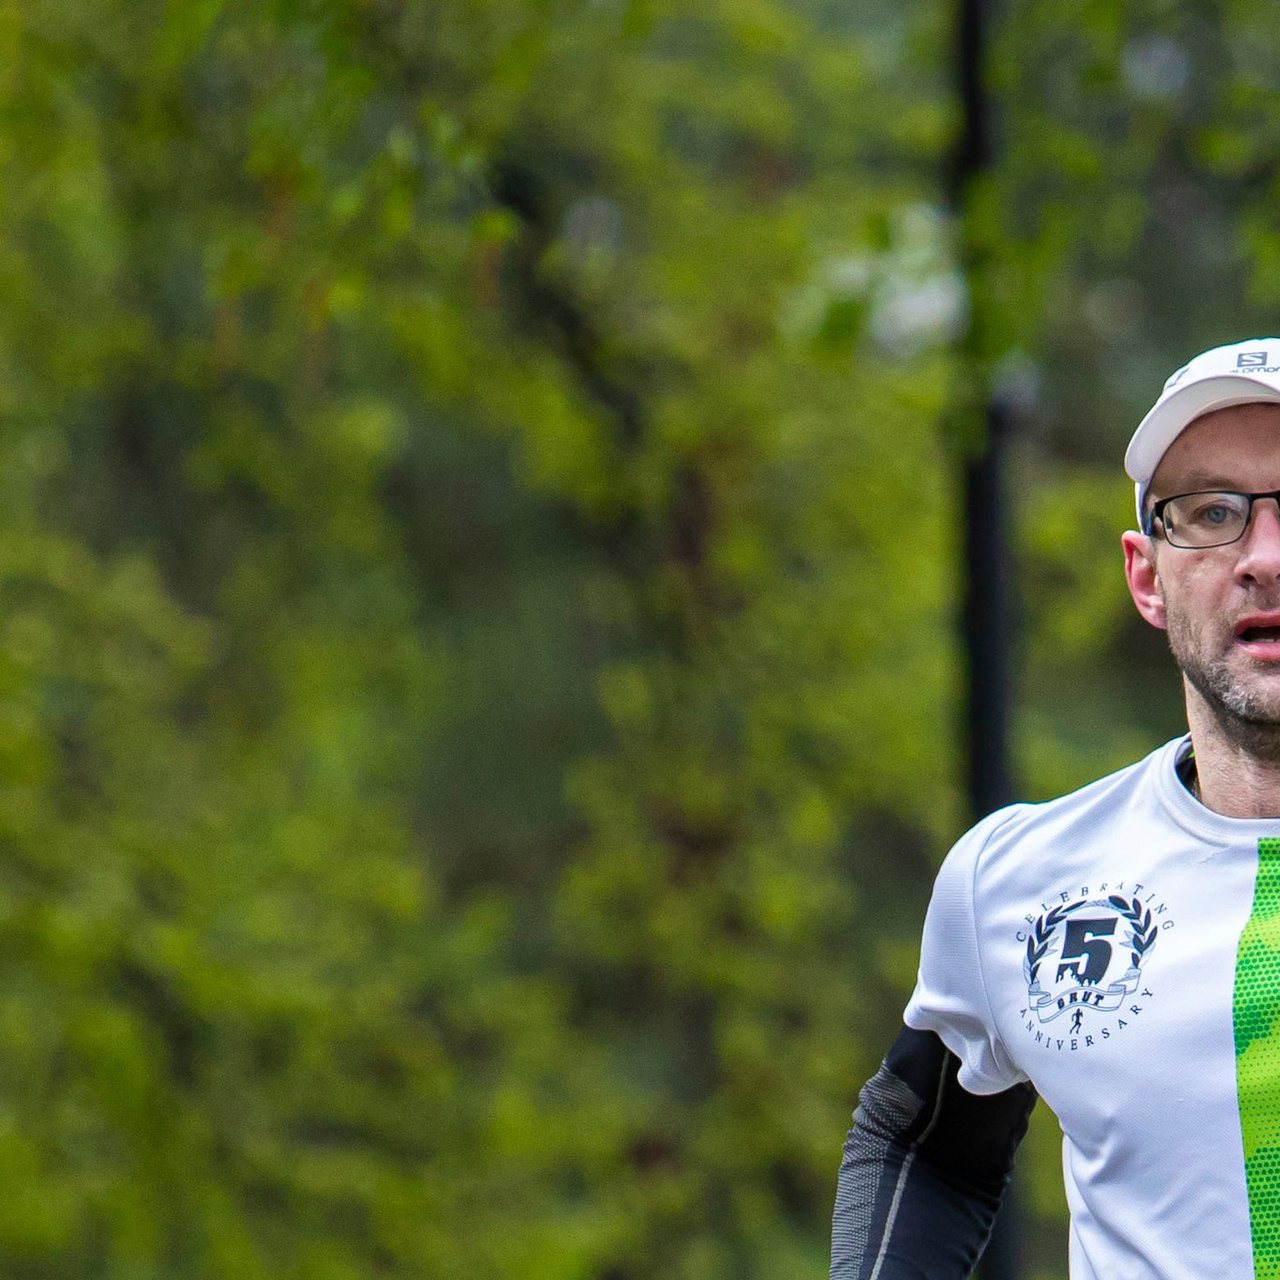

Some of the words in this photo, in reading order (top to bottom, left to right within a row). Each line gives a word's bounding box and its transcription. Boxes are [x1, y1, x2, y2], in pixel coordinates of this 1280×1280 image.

[1016, 881, 1175, 943] CELEBRATING
[1055, 917, 1119, 987] 5
[1019, 987, 1154, 1052] ANNIVERSARY
